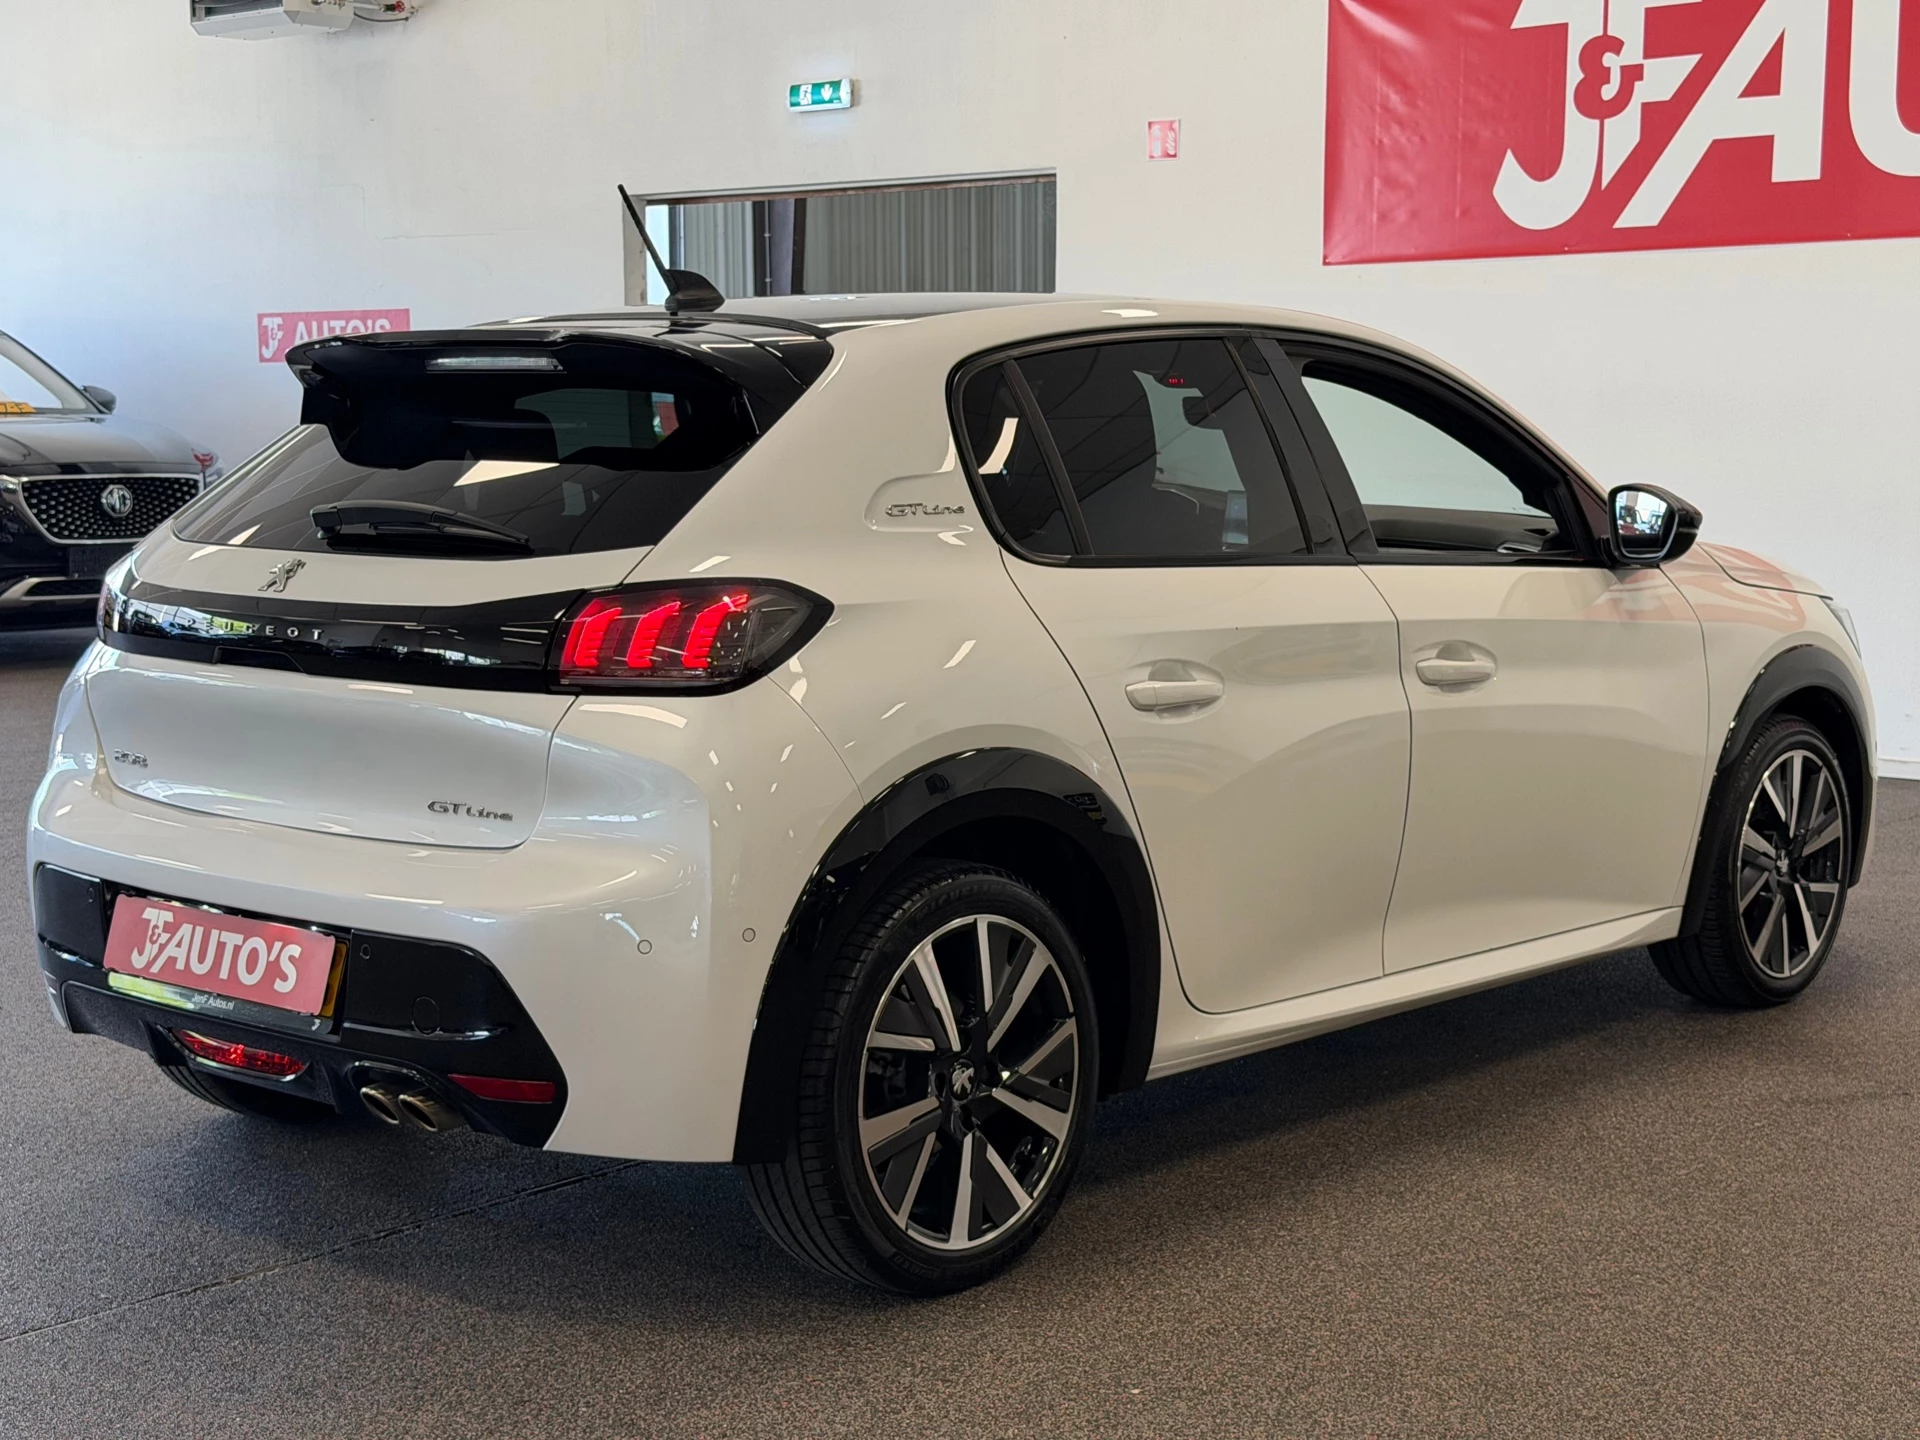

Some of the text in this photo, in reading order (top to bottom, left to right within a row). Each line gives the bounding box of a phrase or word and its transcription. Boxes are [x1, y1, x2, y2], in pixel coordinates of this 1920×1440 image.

[885, 503, 923, 517] GT
[186, 618, 322, 641] PEUGEOT
[114, 748, 149, 768] 208
[427, 800, 467, 816] GT
